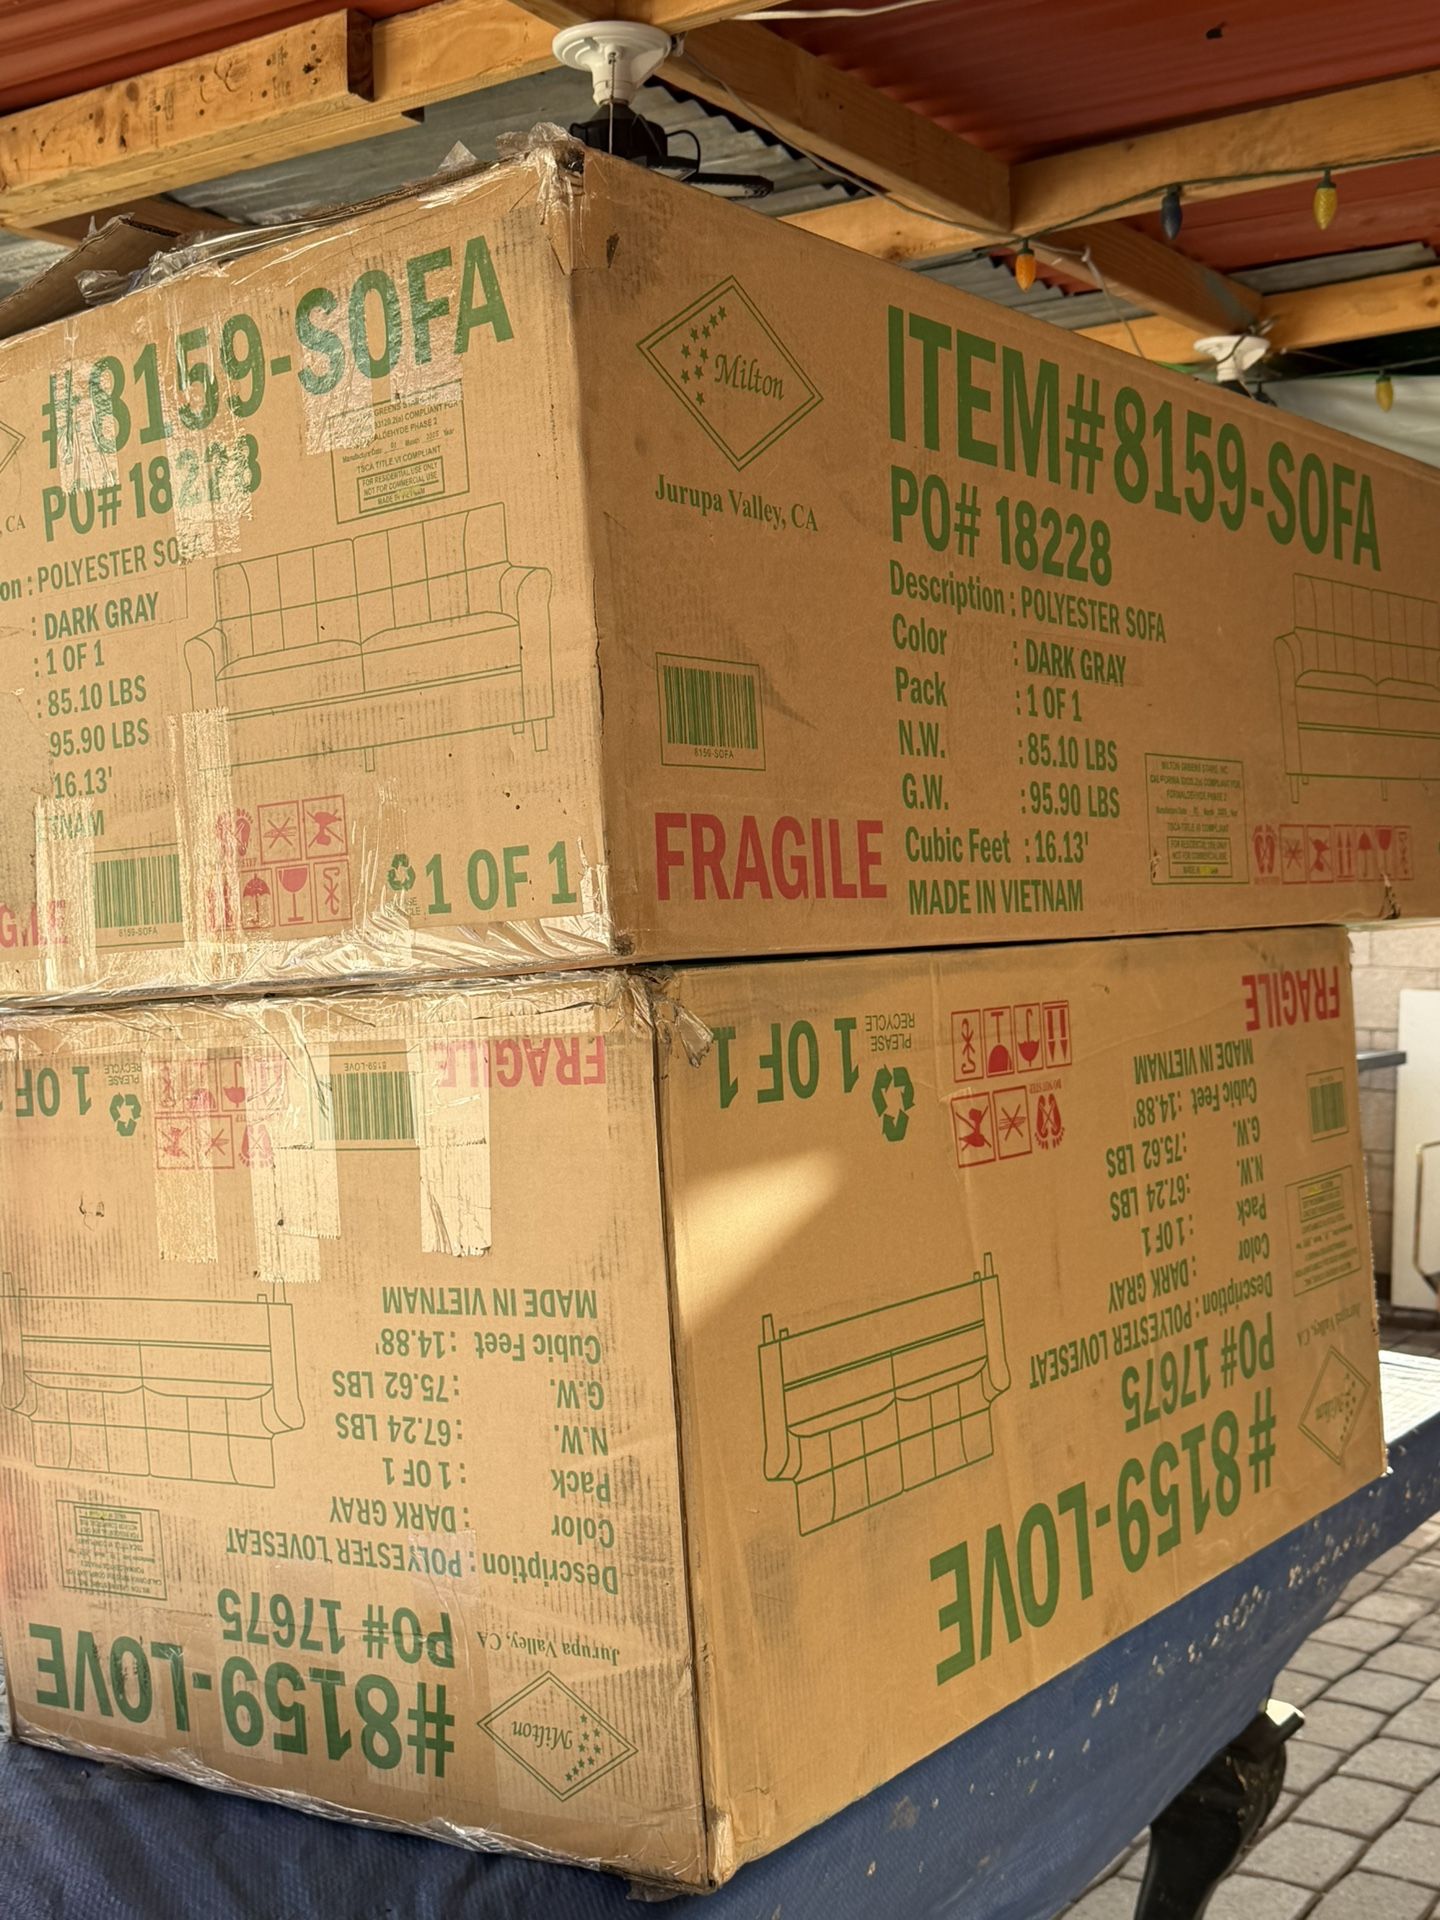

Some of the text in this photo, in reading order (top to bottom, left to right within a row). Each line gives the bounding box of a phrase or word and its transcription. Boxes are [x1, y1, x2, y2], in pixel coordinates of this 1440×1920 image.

[42, 236, 514, 468] #8159-SOFA
[714, 354, 784, 401] Milton
[405, 404, 443, 421] COMPLIANT
[410, 420, 432, 433] PHASE
[433, 417, 438, 425] 2
[403, 446, 441, 462] COMPLIANT
[5, 515, 25, 532] CA
[42, 481, 122, 543] PO#
[656, 474, 818, 531] Jurupa Valley, CA
[890, 464, 1112, 587] PO# 18228
[38, 544, 147, 592] POLYESTER
[45, 592, 159, 640] DARK GRAY
[890, 560, 1166, 643] Description POLYESTER SOFA
[46, 640, 104, 675] 1 OF 1
[892, 613, 1127, 687] Color DARK GRAY
[48, 675, 147, 716] 85.10 LBS
[895, 666, 1082, 722] Pack 1 OF 1
[51, 718, 149, 757] 95.90 LBS
[899, 719, 945, 758] N.W.
[1085, 738, 1118, 772] LBS
[53, 766, 112, 799] 16.13'
[902, 773, 949, 810] G.W.
[1088, 785, 1120, 818] LBS
[655, 812, 887, 900] FRAGILE
[905, 826, 963, 863] Cubic
[968, 828, 1011, 864] Feet
[426, 841, 577, 914] 1 OF 1
[909, 879, 1083, 915] MADE IN VIETNAM
[1242, 966, 1340, 1031] FRAGILE
[865, 1013, 915, 1031] RECYCLE
[870, 1033, 912, 1052] PLEASE
[104, 1064, 141, 1074] RECYCLE
[108, 1075, 140, 1086] PLEASE
[429, 1035, 606, 1088] FRAGILE
[710, 1017, 859, 1109] 1 OF 1
[1134, 1038, 1253, 1084] MADE IN VIETNAM
[16, 1066, 92, 1117] 1 OF
[1191, 1084, 1220, 1115] Feet
[1223, 1077, 1257, 1107] Cubic
[1233, 1116, 1260, 1147] G.W.
[1106, 1144, 1135, 1178] LBS
[1237, 1154, 1263, 1186] N.W.
[1110, 1187, 1138, 1222] LBS
[1141, 1193, 1266, 1256] Pack 1 OF 1
[1108, 1233, 1269, 1313] Color DARK GRAY
[382, 1287, 597, 1319] MADE IN VIETNAM
[474, 1332, 525, 1362] Feet
[533, 1334, 601, 1365] Cubic
[1029, 1271, 1272, 1389] Description POLYESTER LOVESEAT
[331, 1370, 374, 1399] LBS
[1121, 1312, 1275, 1433] PO# 17675
[550, 1379, 604, 1410] G.W.
[335, 1413, 378, 1442] LBS
[554, 1425, 609, 1456] N.W.
[382, 1458, 610, 1503] Pack 1 OF 1
[329, 1496, 615, 1549] Color DARK GRAY
[929, 1387, 1276, 1687] #8159-LOVE
[226, 1527, 618, 1595] Description POLYESTER LOVESEAT
[216, 1588, 455, 1668] PO# 17675
[476, 1631, 620, 1666] Jurupa Valley, CA
[28, 1622, 456, 1779] #8159-LOVE
[511, 1720, 573, 1750] Milton
